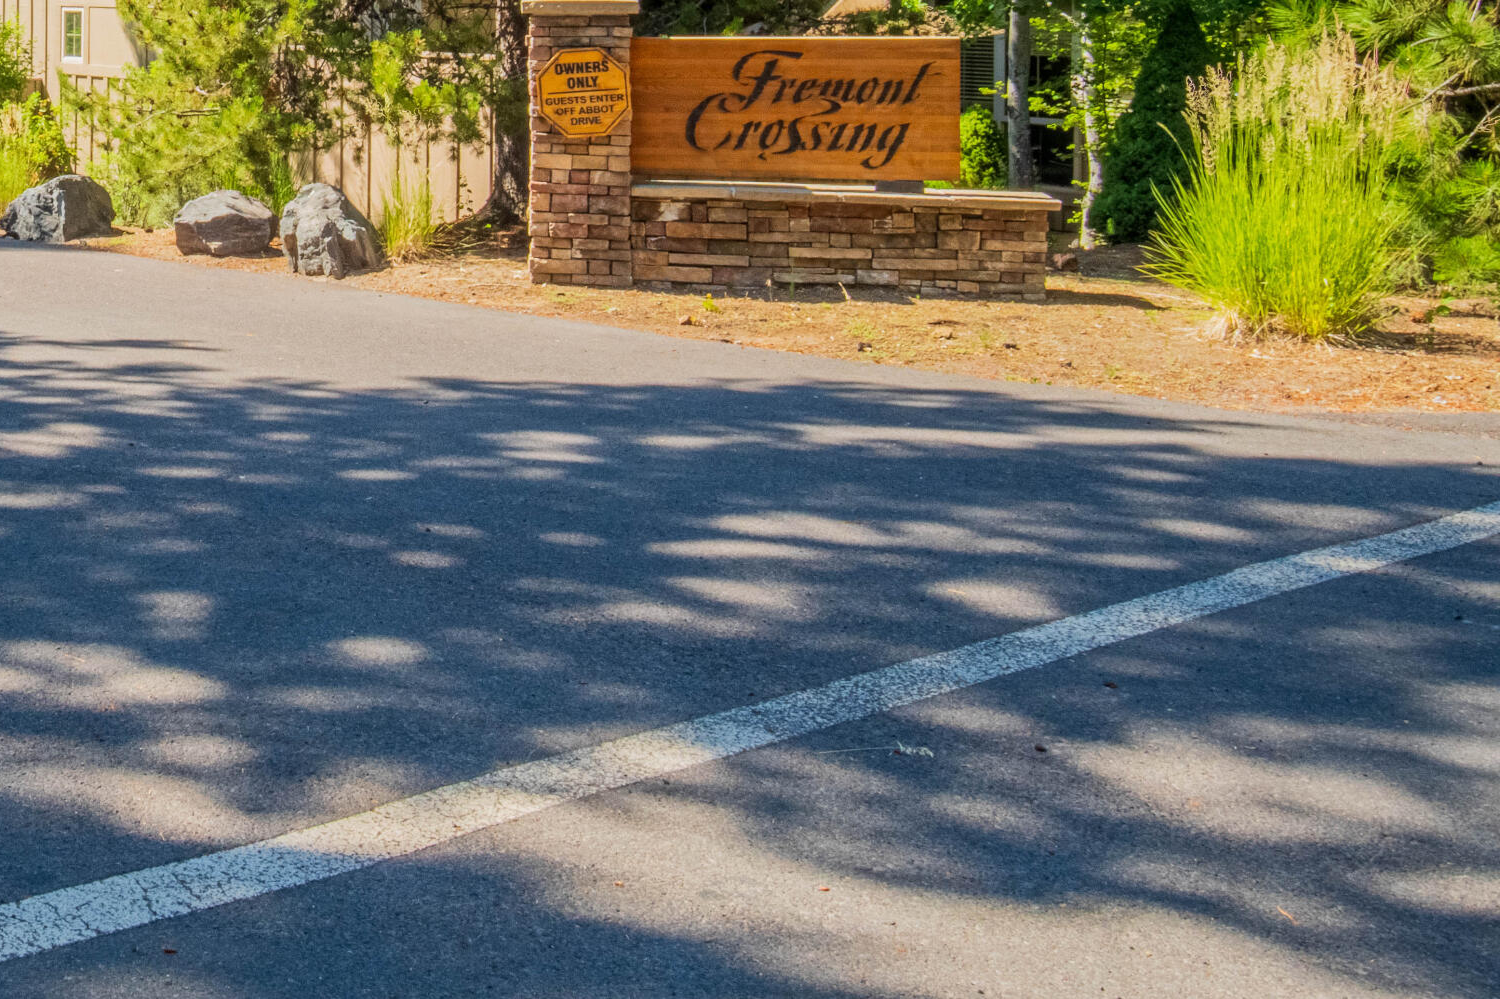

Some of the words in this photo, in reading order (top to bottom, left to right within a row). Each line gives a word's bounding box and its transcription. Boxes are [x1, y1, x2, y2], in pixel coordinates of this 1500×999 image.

[554, 60, 609, 75] OWNERS
[567, 76, 599, 89] ONLY
[732, 50, 946, 112] Fremont
[545, 95, 587, 105] GUESTS
[590, 93, 625, 103] ENTER
[555, 107, 576, 116] OFF
[578, 104, 615, 115] ABBOT
[570, 116, 602, 126] DRIVE
[685, 93, 910, 170] Crossing
